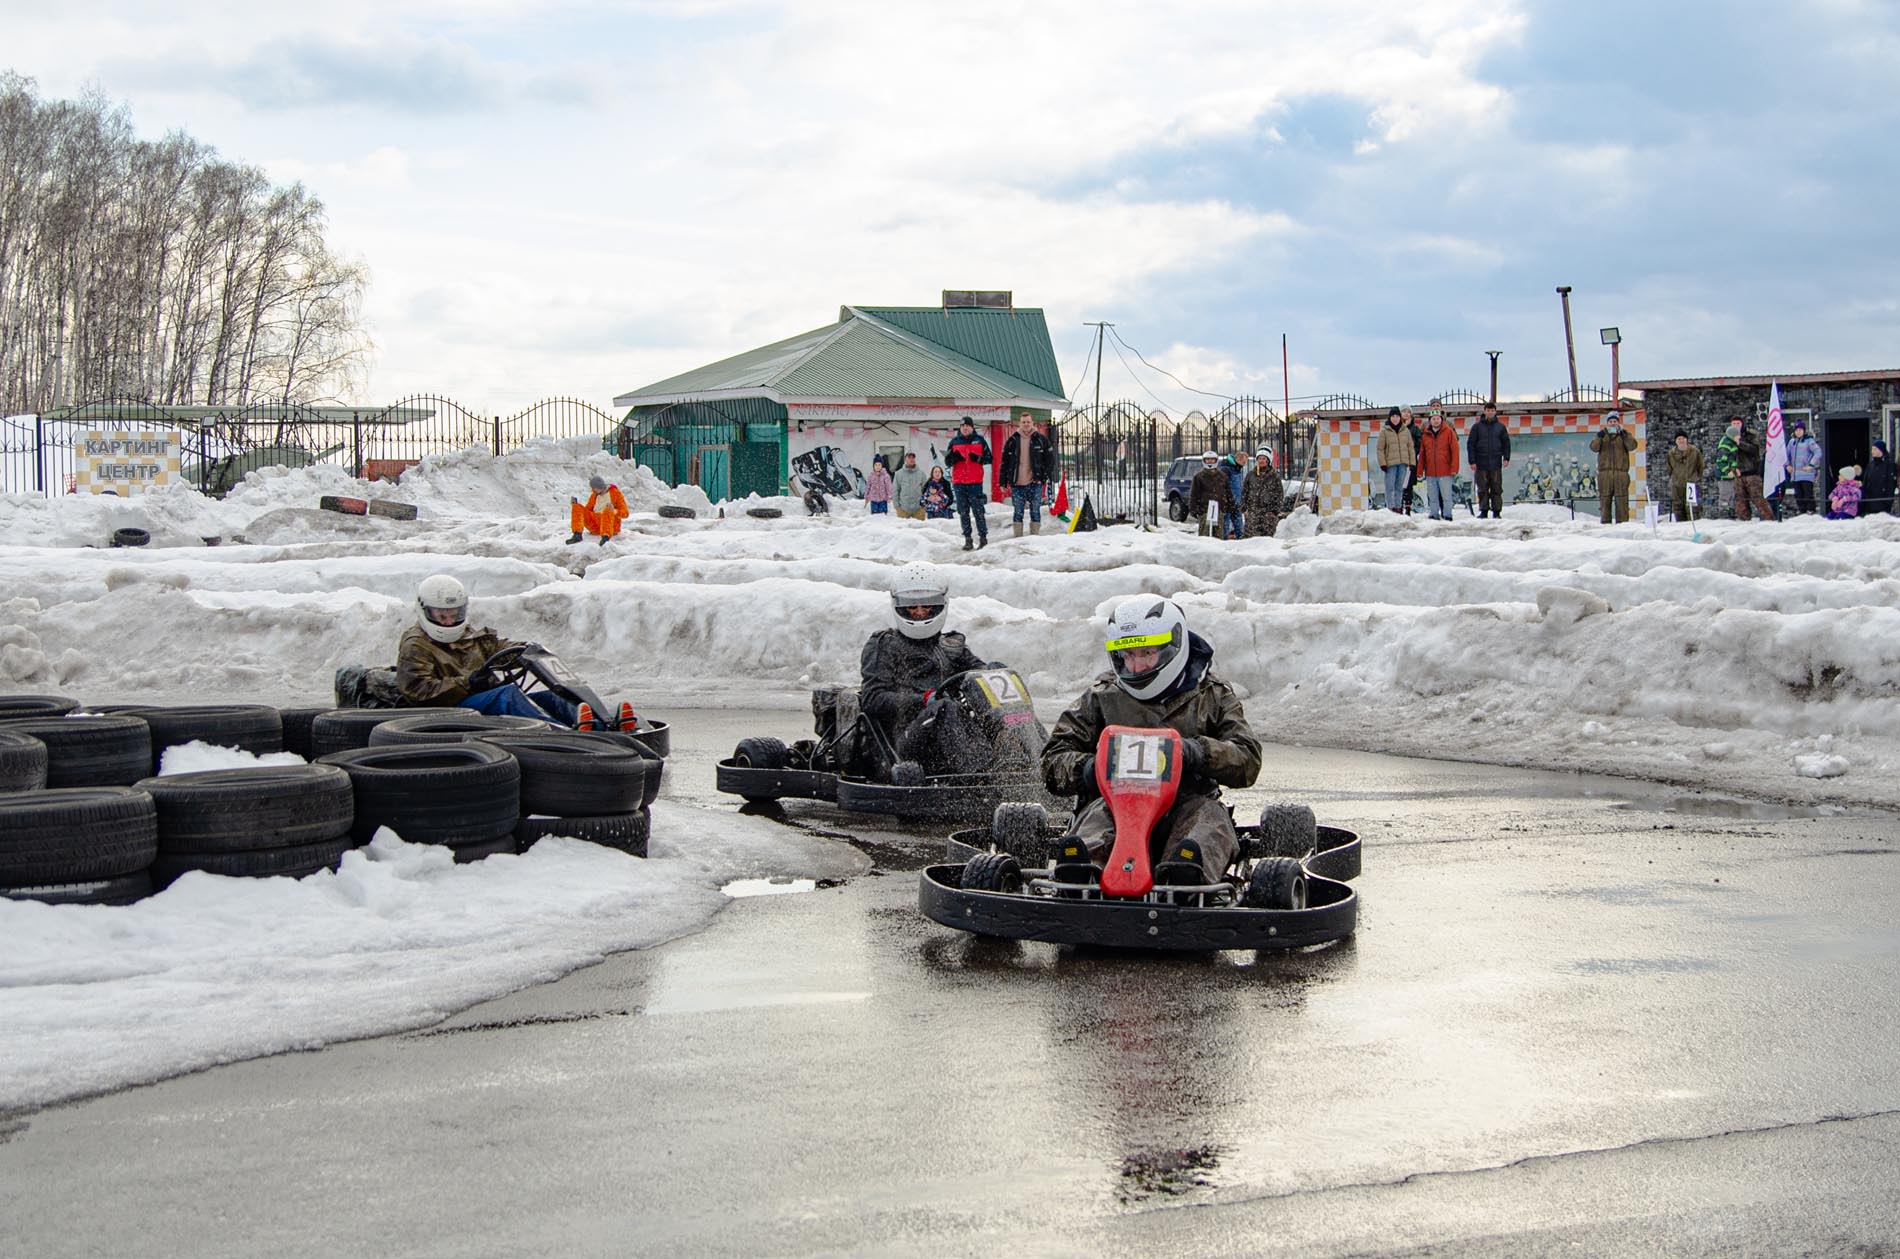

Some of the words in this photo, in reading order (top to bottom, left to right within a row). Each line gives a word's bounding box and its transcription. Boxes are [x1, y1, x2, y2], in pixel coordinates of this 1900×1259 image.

[85, 440, 171, 455] КАРТИНГ
[97, 464, 160, 481] ЦЕНТР
[1688, 486, 1694, 500] 2
[1113, 637, 1147, 646] SUBARU
[989, 675, 1018, 700] 2
[1126, 740, 1153, 774] 1
